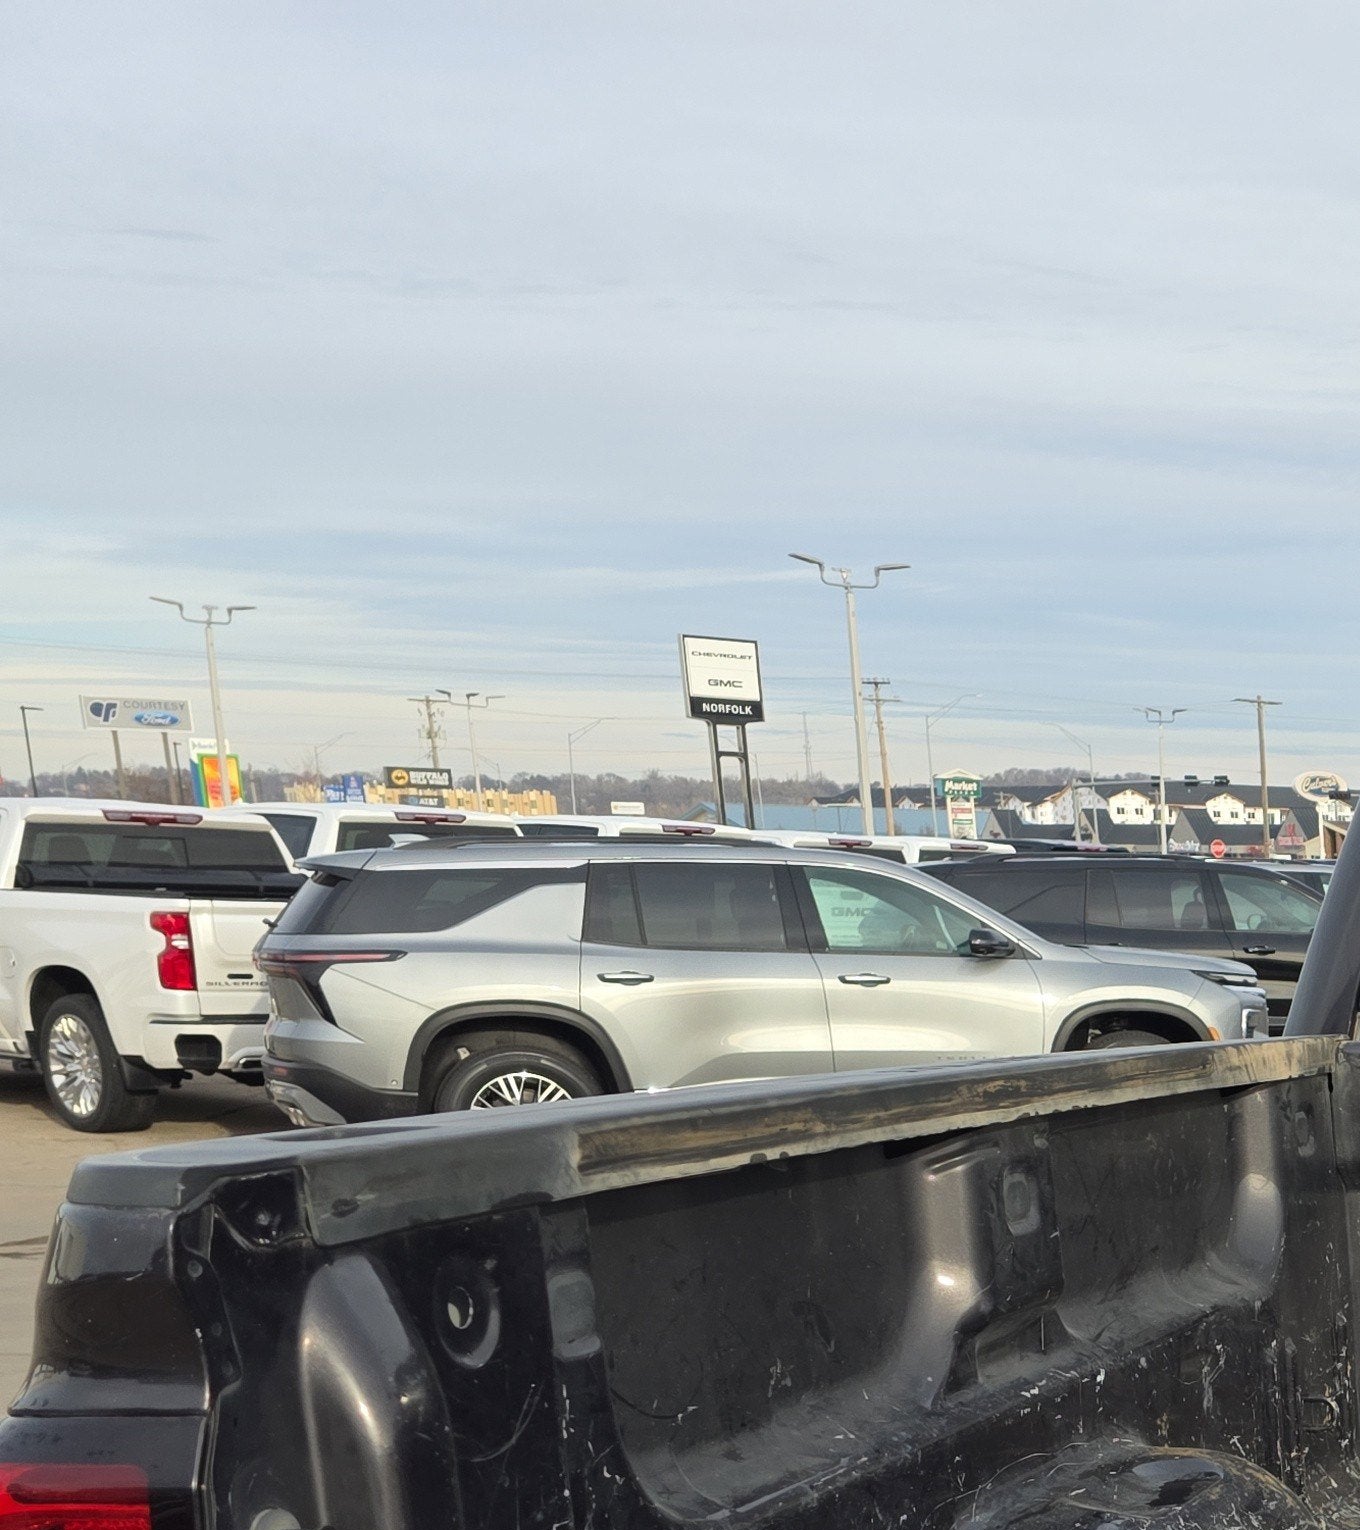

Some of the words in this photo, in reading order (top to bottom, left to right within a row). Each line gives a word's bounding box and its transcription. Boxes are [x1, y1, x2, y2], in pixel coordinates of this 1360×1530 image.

[691, 650, 753, 660] CHEVROLET
[707, 678, 743, 688] GMC
[123, 699, 185, 711] COURTESY
[702, 702, 752, 715] NORFOLK
[409, 770, 448, 779] BUFFALO
[944, 780, 977, 792] Market
